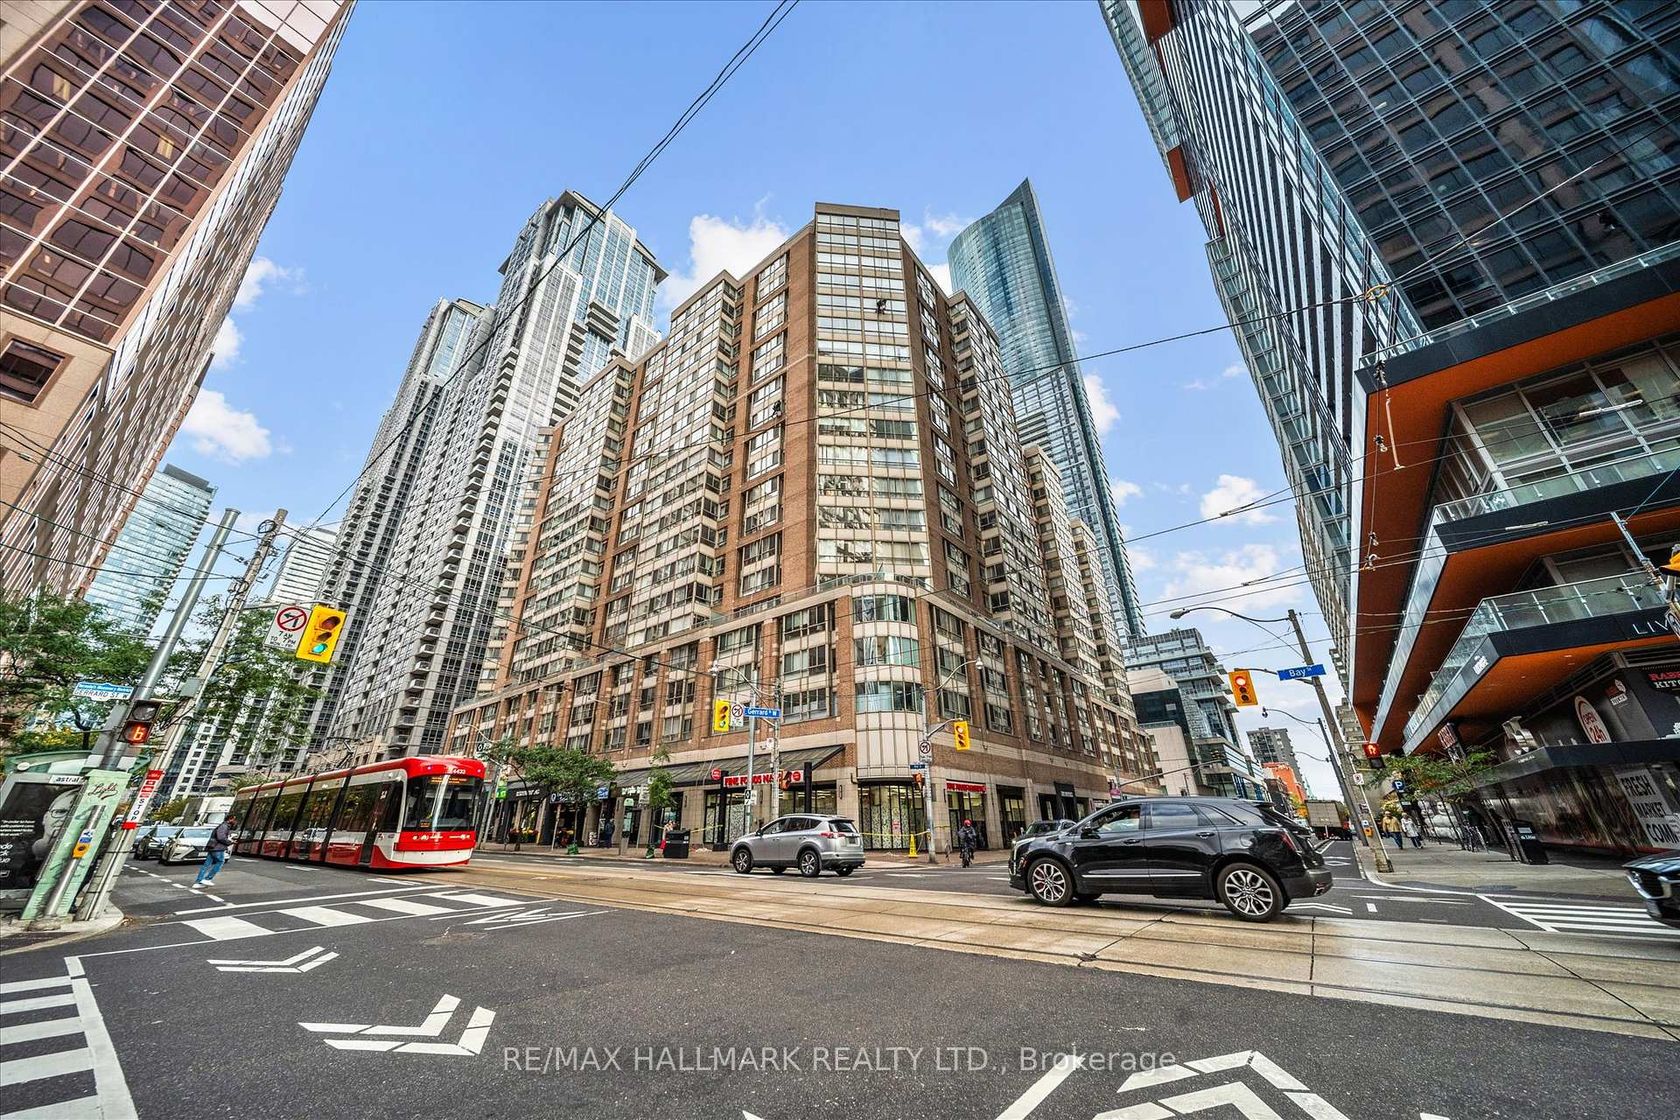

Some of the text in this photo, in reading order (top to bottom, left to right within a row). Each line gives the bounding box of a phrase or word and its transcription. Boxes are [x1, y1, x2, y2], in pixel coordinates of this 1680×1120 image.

[1289, 668, 1306, 677] Bay
[747, 707, 768, 716] Gerrard
[740, 775, 762, 785] FODS
[1620, 774, 1656, 797] FRESH
[130, 798, 145, 821] STOP
[1633, 801, 1667, 819] MARKET
